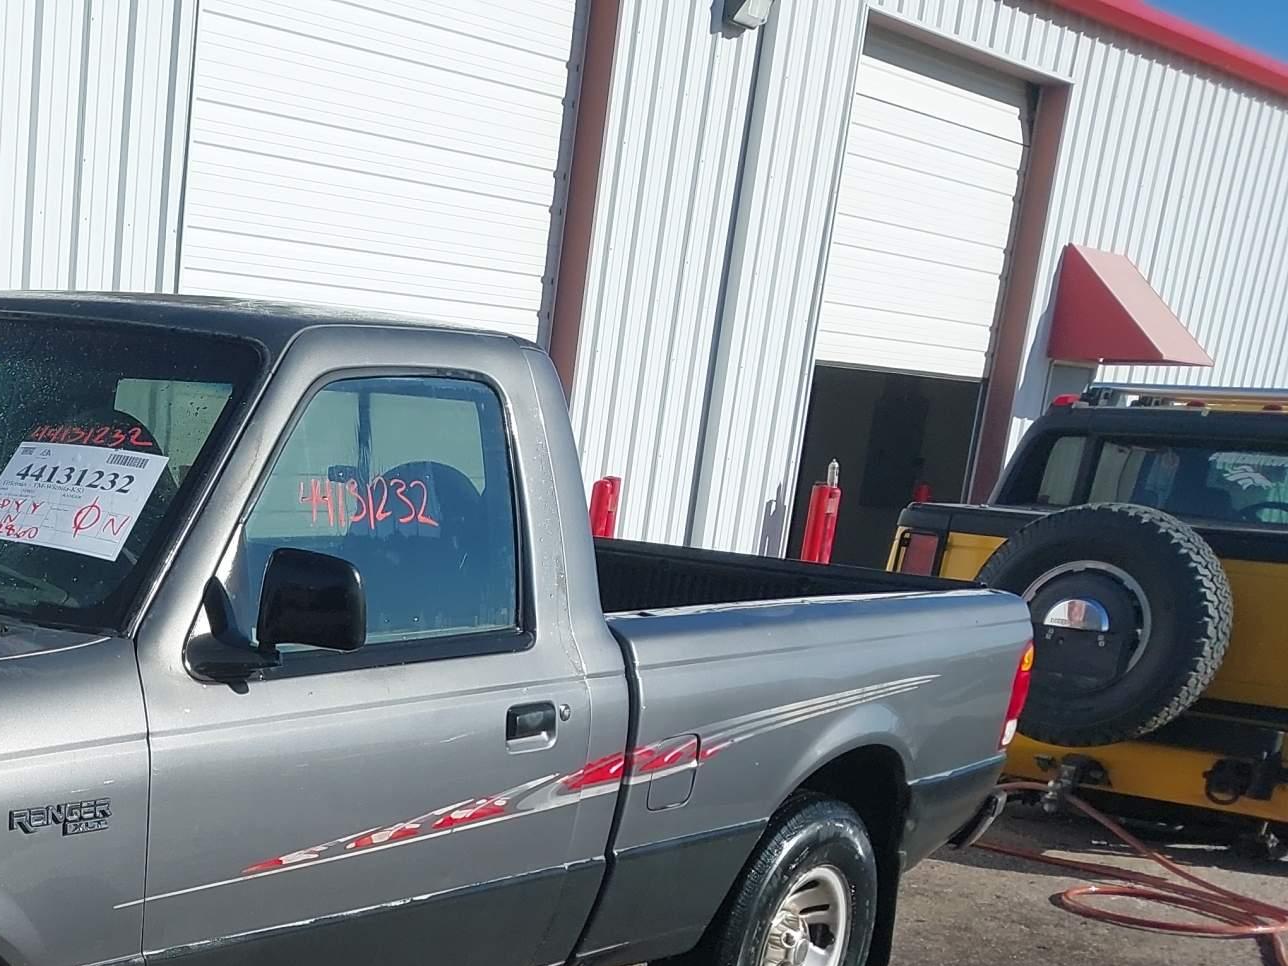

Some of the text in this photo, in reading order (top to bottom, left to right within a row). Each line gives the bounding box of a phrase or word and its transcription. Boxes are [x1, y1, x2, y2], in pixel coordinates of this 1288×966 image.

[16, 462, 136, 494] 44131232
[299, 476, 440, 530] 44131232
[8, 798, 113, 834] RANGER
